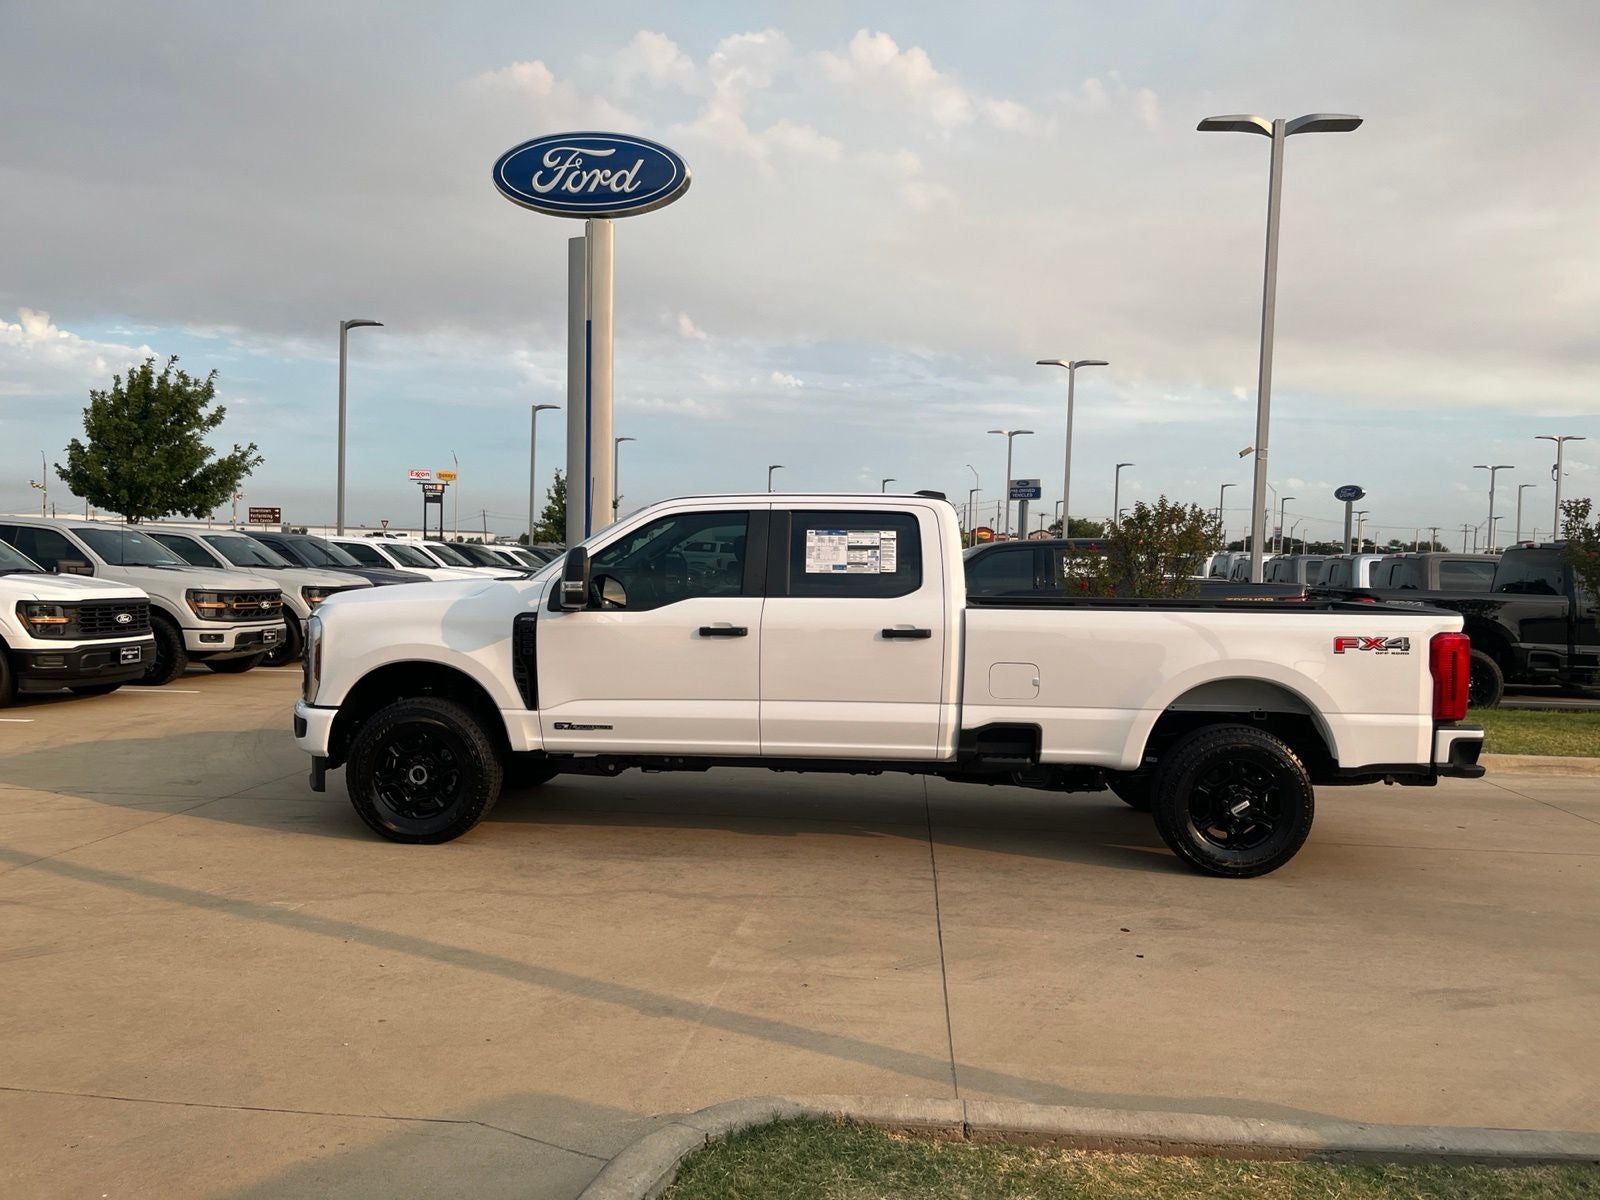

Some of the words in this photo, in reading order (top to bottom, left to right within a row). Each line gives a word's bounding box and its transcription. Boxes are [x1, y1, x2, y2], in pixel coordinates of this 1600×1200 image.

[532, 146, 645, 194] Ford
[410, 470, 430, 478] Exxon
[1340, 488, 1357, 498] Ford
[1333, 636, 1411, 654] FX4
